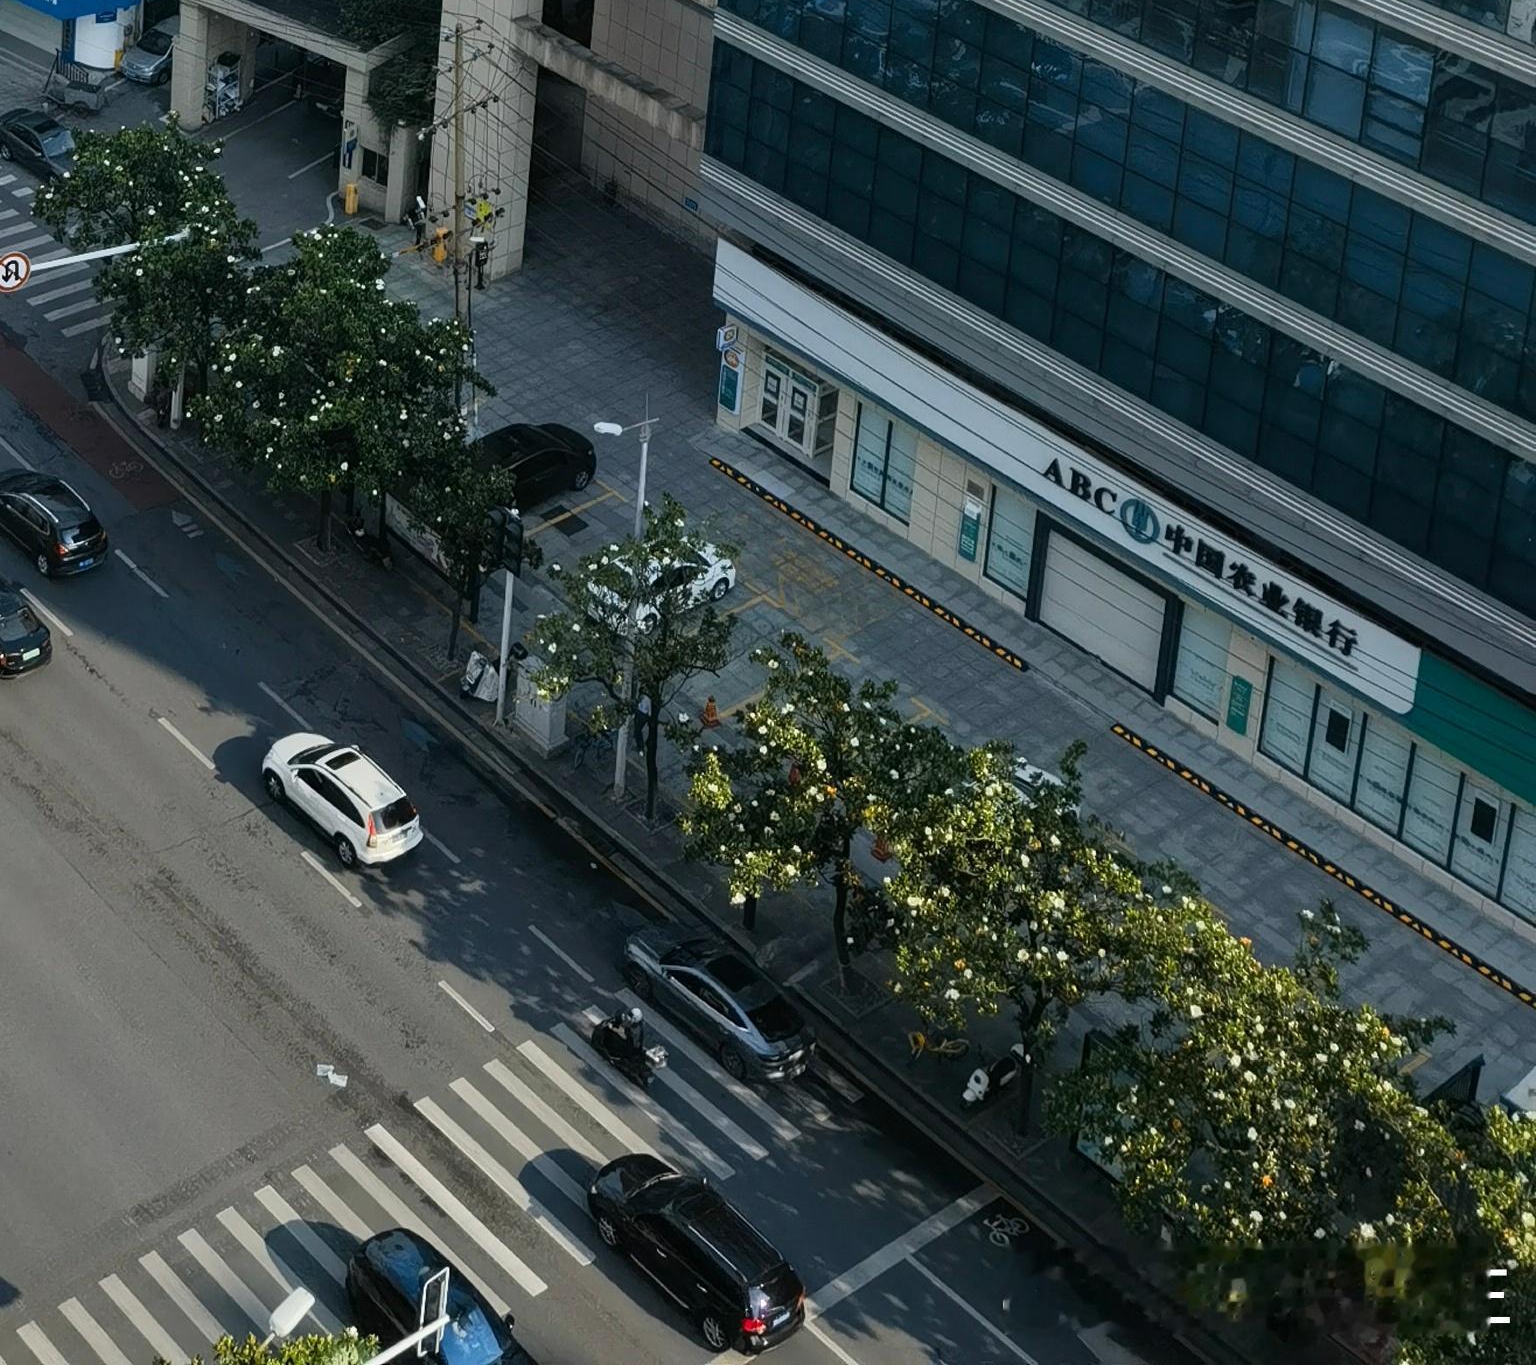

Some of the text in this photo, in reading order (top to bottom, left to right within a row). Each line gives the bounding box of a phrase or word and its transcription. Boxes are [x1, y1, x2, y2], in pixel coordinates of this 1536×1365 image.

[1042, 457, 1118, 515] ABC
[1164, 522, 1361, 657] 中国农业银行
